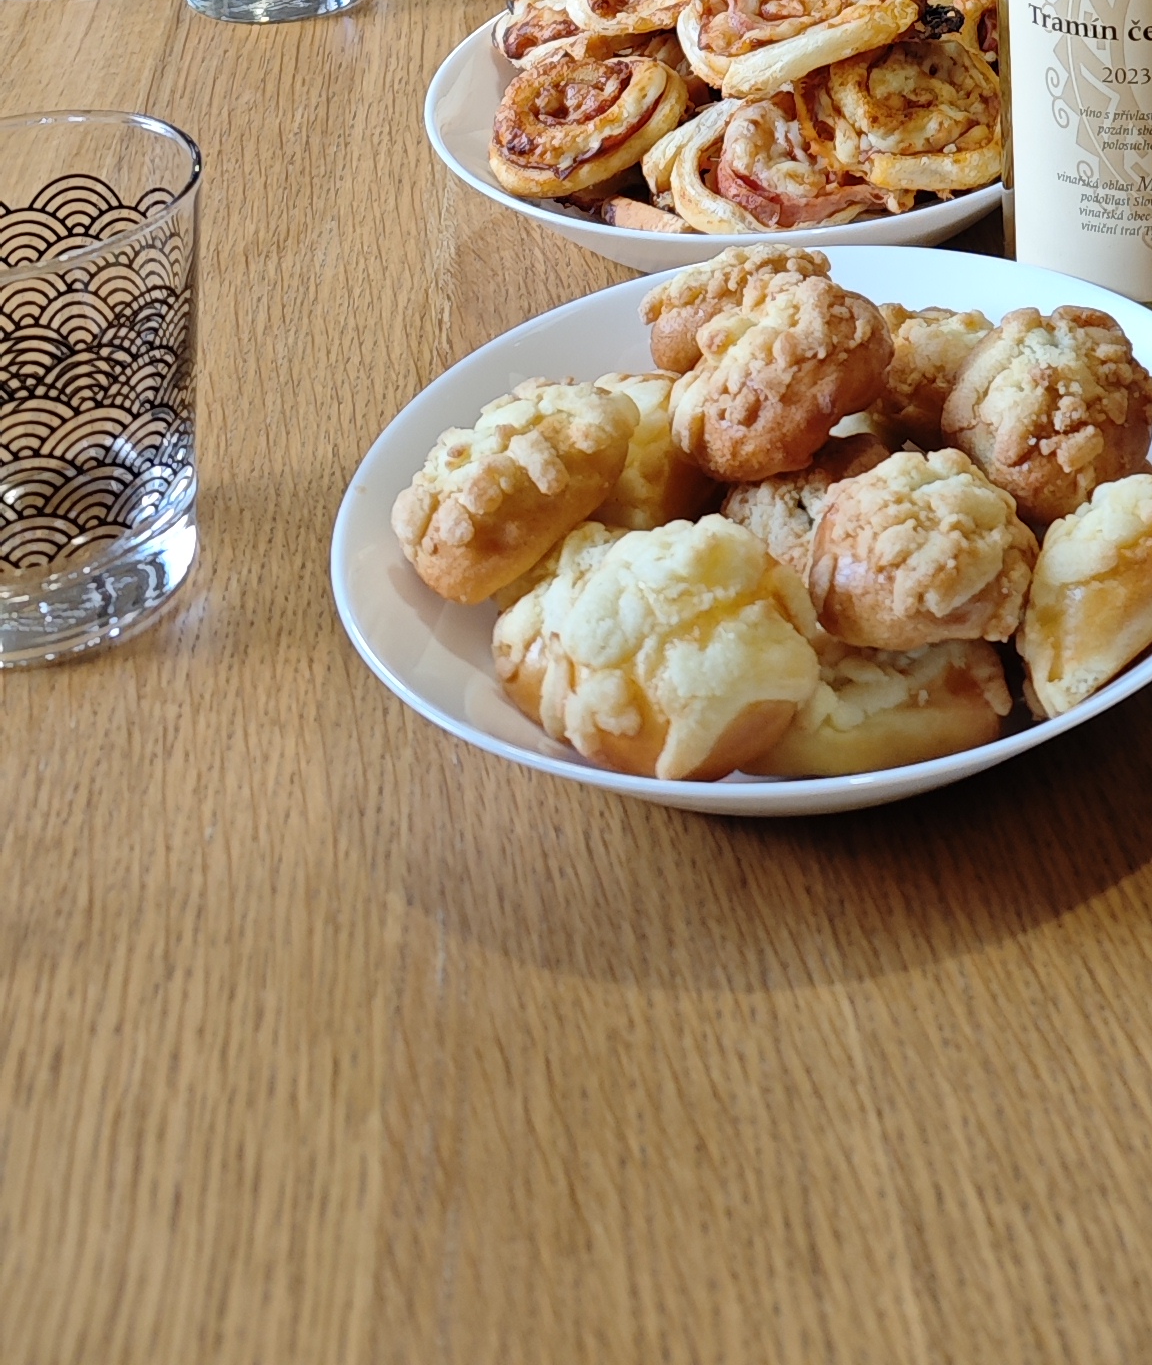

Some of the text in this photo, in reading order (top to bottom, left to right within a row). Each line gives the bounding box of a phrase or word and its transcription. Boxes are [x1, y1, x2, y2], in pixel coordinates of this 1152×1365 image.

[1028, 3, 1119, 41] Tramín
[1101, 66, 1152, 85] 2023
[1079, 107, 1103, 119] víno
[1104, 110, 1111, 119] s
[1097, 123, 1135, 136] pozdní
[1056, 171, 1100, 189] vinařská
[1101, 179, 1135, 192] oblast
[1080, 192, 1131, 207] podoblast
[1079, 205, 1124, 221] vinařská
[1126, 210, 1150, 222] obec
[1081, 220, 1119, 235] viniční
